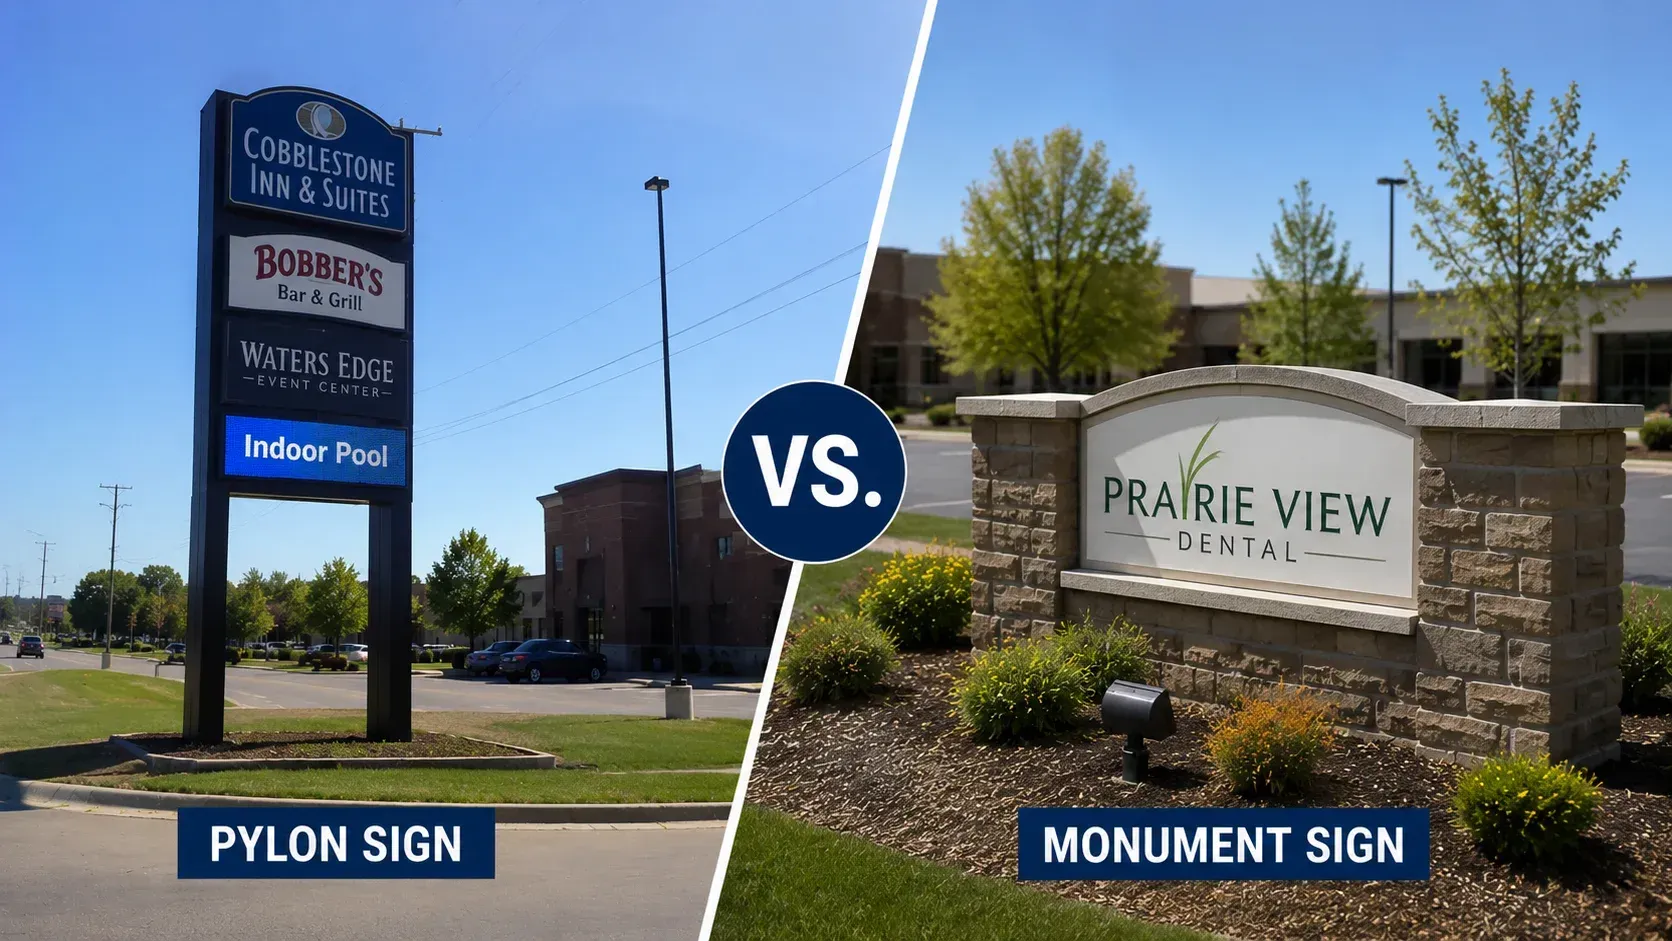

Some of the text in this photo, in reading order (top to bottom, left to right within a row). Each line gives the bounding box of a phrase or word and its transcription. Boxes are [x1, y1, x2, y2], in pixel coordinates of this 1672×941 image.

[243, 127, 396, 187] COBBLESTONE
[250, 163, 390, 218] INN & SUITES
[254, 244, 384, 296] BOBBER'S
[277, 284, 363, 311] Bar & Grill
[240, 340, 394, 383] WATERS EDGE
[257, 375, 380, 398] EVENT CENTER
[244, 434, 388, 468] Indoor Pool
[1104, 475, 1392, 537] PRAIRIE VIEW
[1178, 530, 1297, 563] DENTAL
